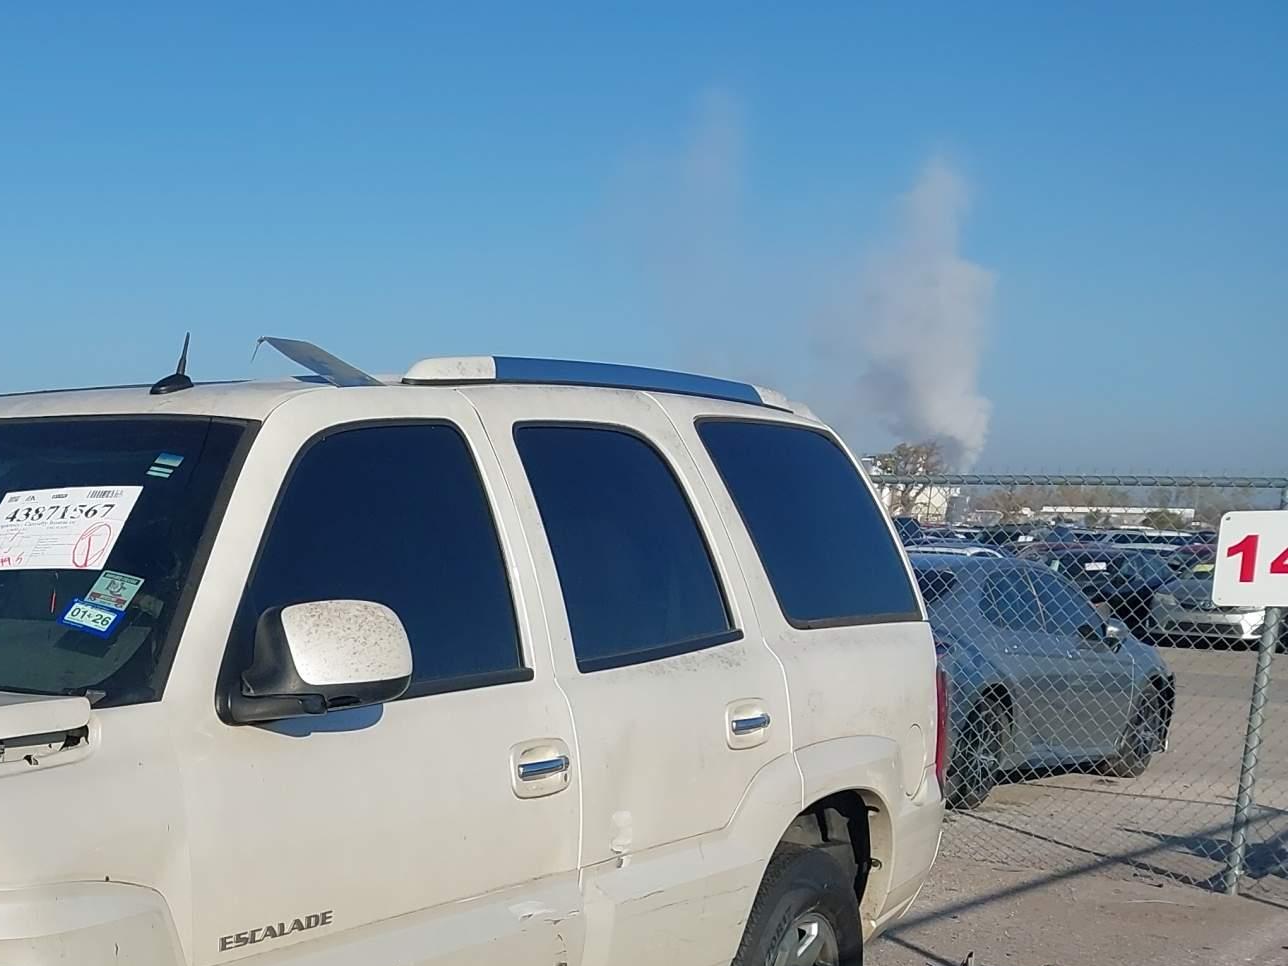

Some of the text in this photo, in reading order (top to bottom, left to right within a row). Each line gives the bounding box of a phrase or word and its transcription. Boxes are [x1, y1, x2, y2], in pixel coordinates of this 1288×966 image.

[4, 503, 116, 522] 43871567
[70, 607, 112, 626] 01 26
[218, 909, 334, 952] ESCALADE
